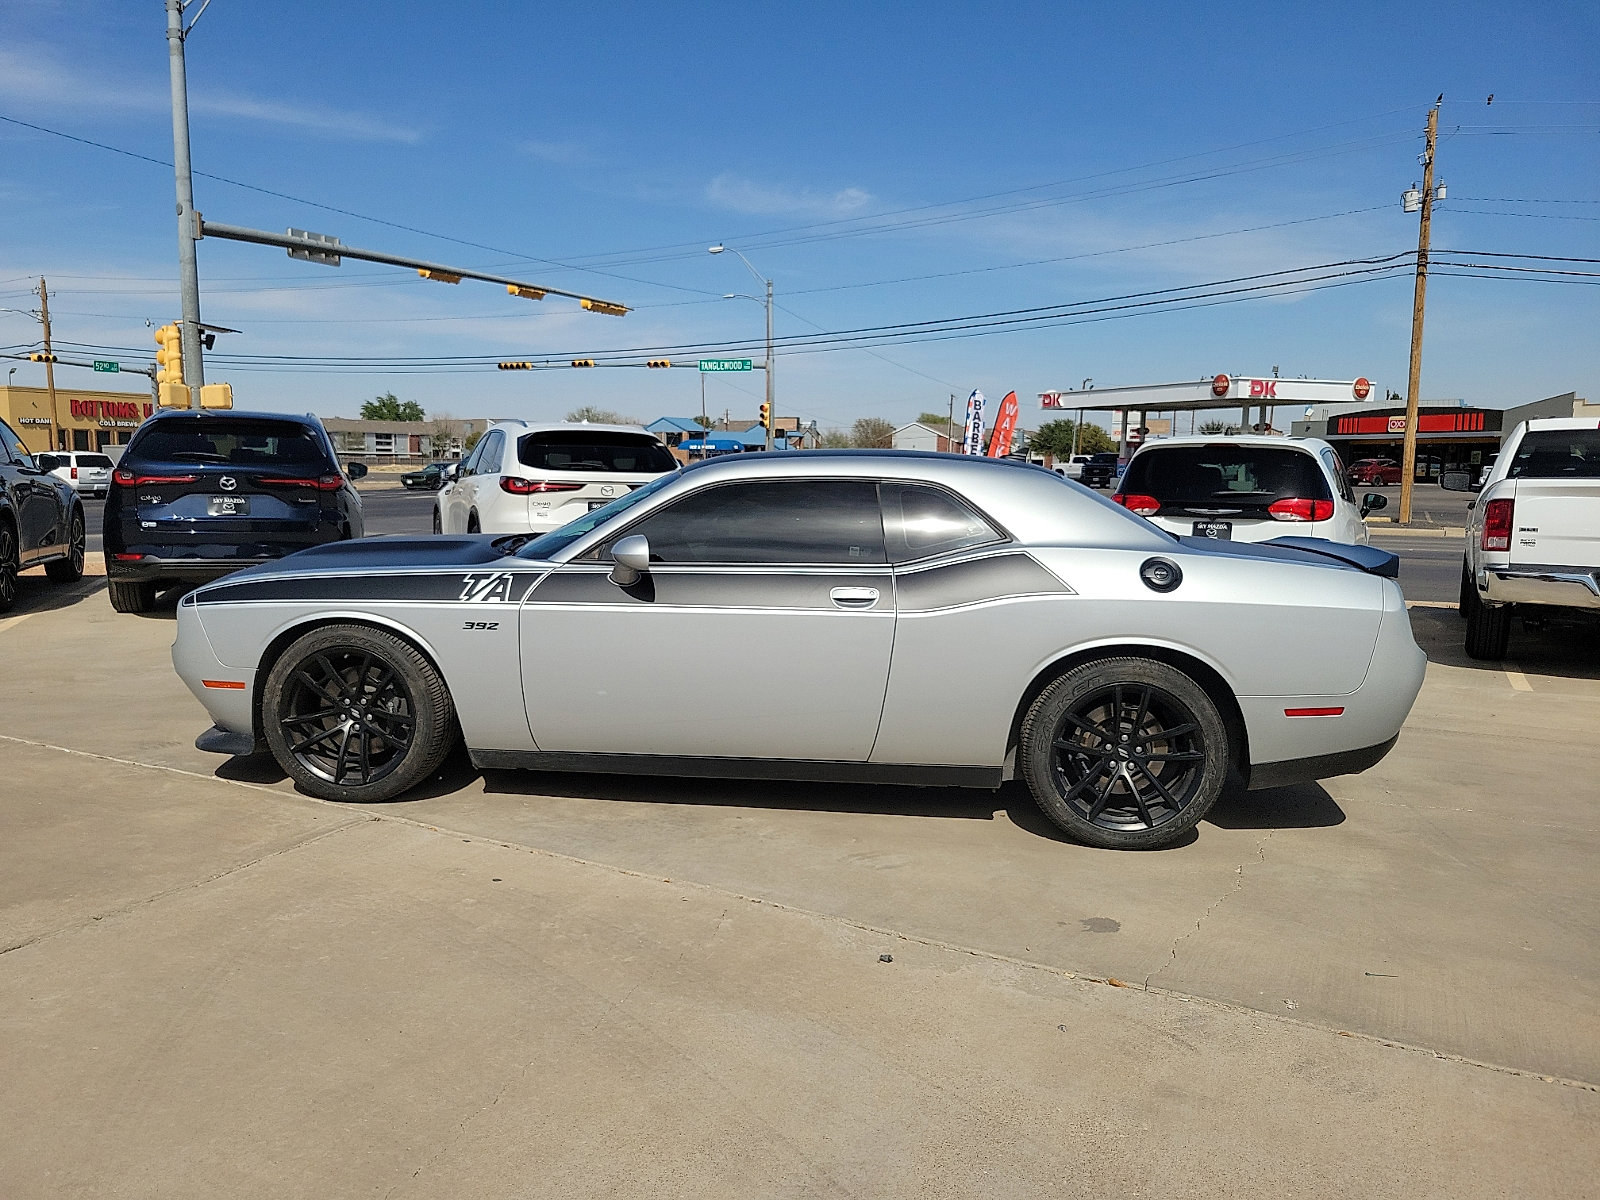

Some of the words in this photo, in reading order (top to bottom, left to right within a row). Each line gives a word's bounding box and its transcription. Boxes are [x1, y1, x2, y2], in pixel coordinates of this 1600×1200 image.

[701, 361, 742, 370] TANGLEWOOD
[1250, 380, 1276, 396] DK
[1042, 394, 1061, 407] DK
[70, 399, 138, 418] BOTTOMS
[462, 621, 500, 630] 392
